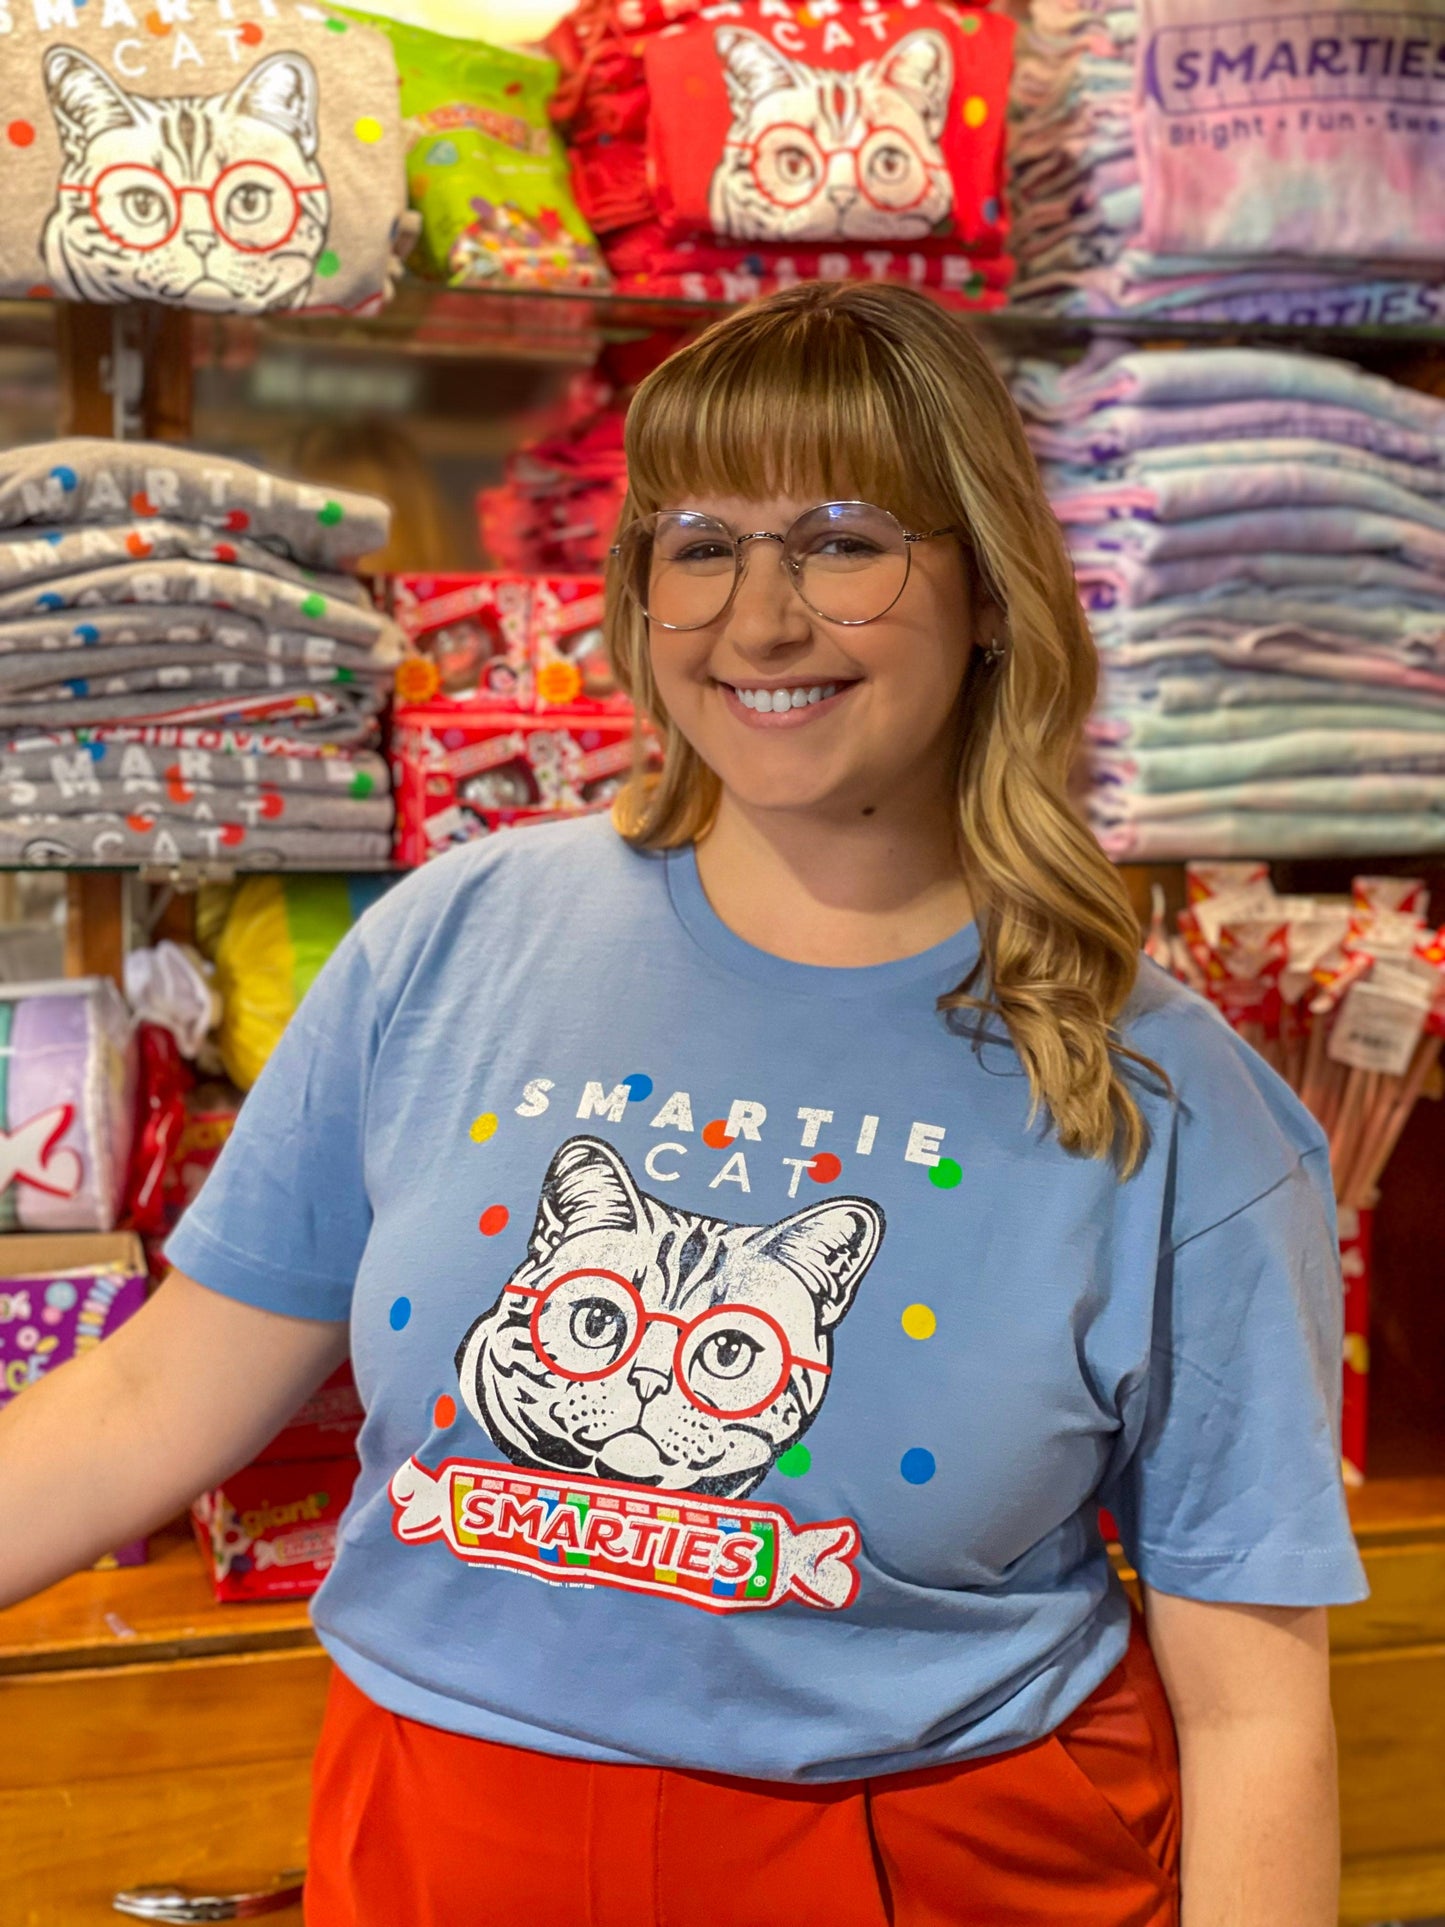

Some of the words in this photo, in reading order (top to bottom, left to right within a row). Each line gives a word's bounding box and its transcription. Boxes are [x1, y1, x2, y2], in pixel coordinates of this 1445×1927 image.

[112, 28, 246, 77] CAT
[772, 12, 889, 53] CAT
[20, 467, 327, 513] MARTIE
[92, 830, 230, 866] CAT
[514, 1077, 946, 1168] SMARTIE
[643, 1141, 818, 1199] CAT
[459, 1490, 764, 1583] SMARTIES
